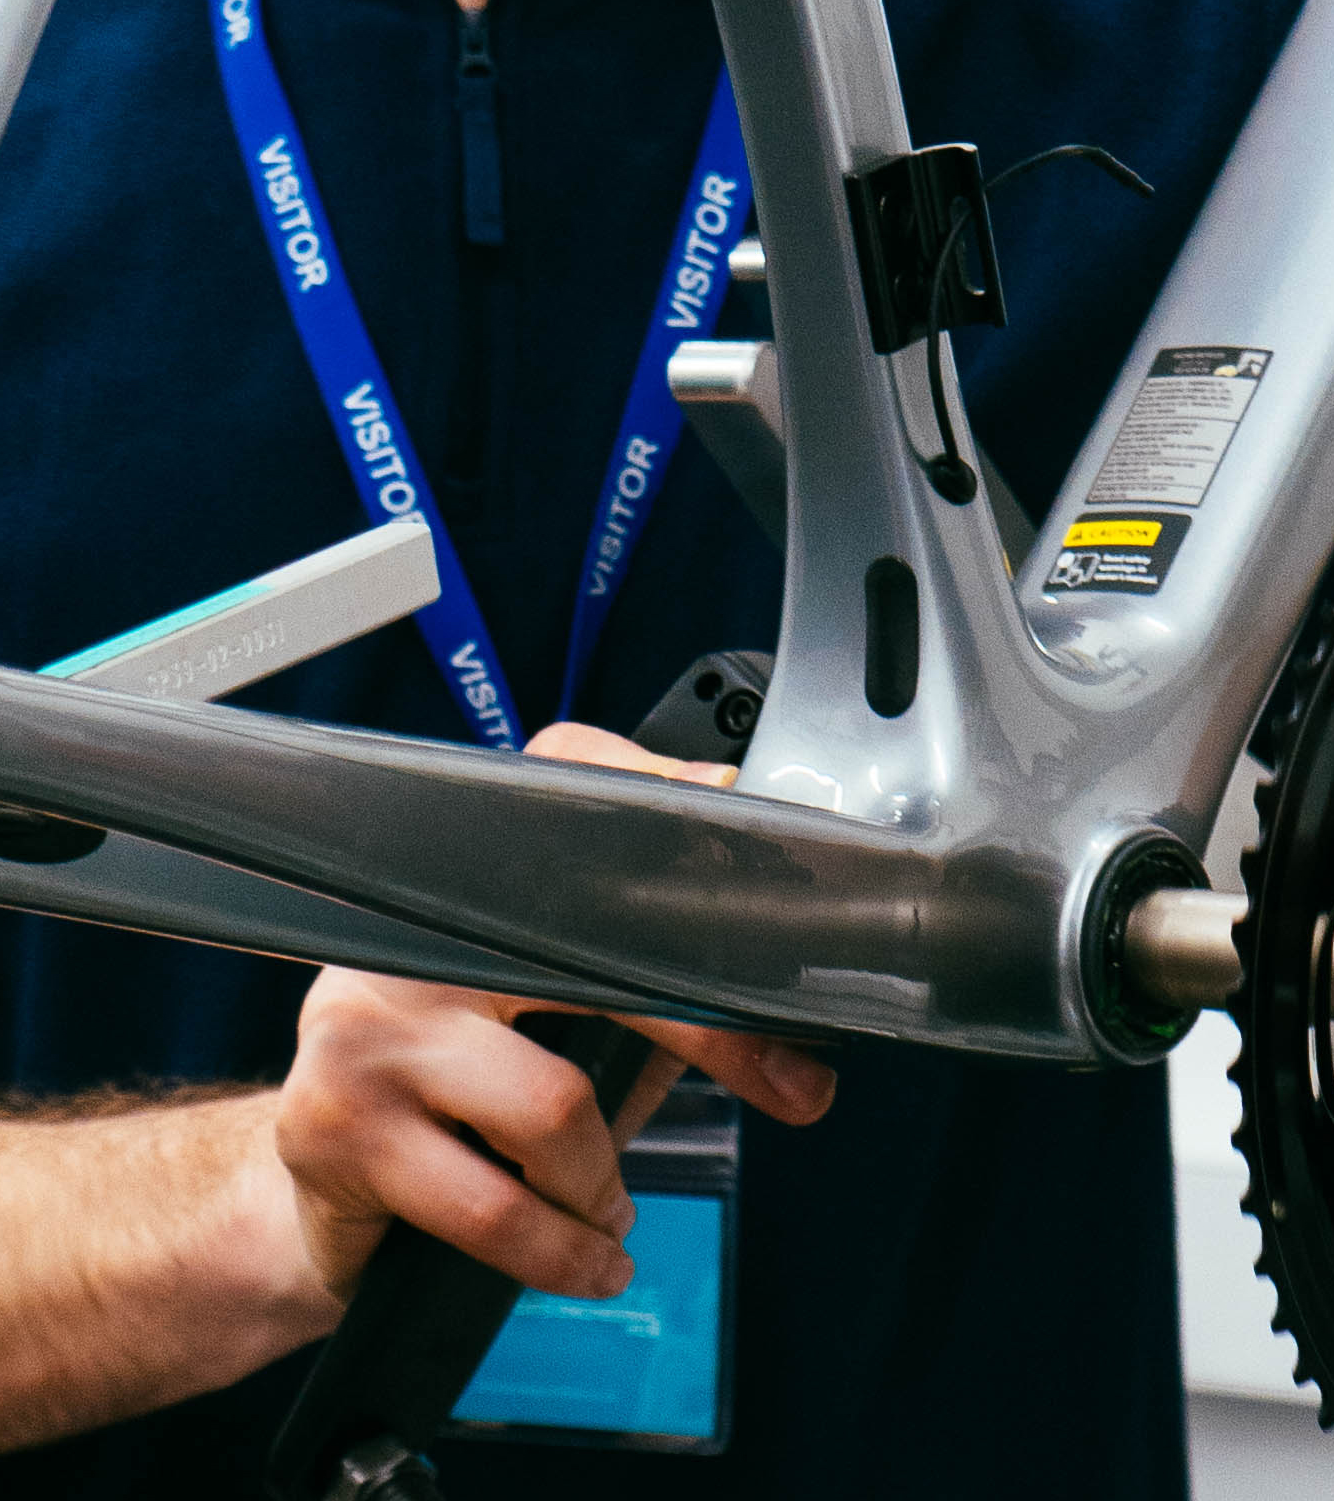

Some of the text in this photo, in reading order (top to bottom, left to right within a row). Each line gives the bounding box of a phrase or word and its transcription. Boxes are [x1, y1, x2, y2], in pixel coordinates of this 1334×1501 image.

[258, 137, 330, 292] VISITOR
[665, 173, 737, 330] VISITOR
[588, 436, 658, 598] VISITOR
[451, 642, 519, 752] VISIT
